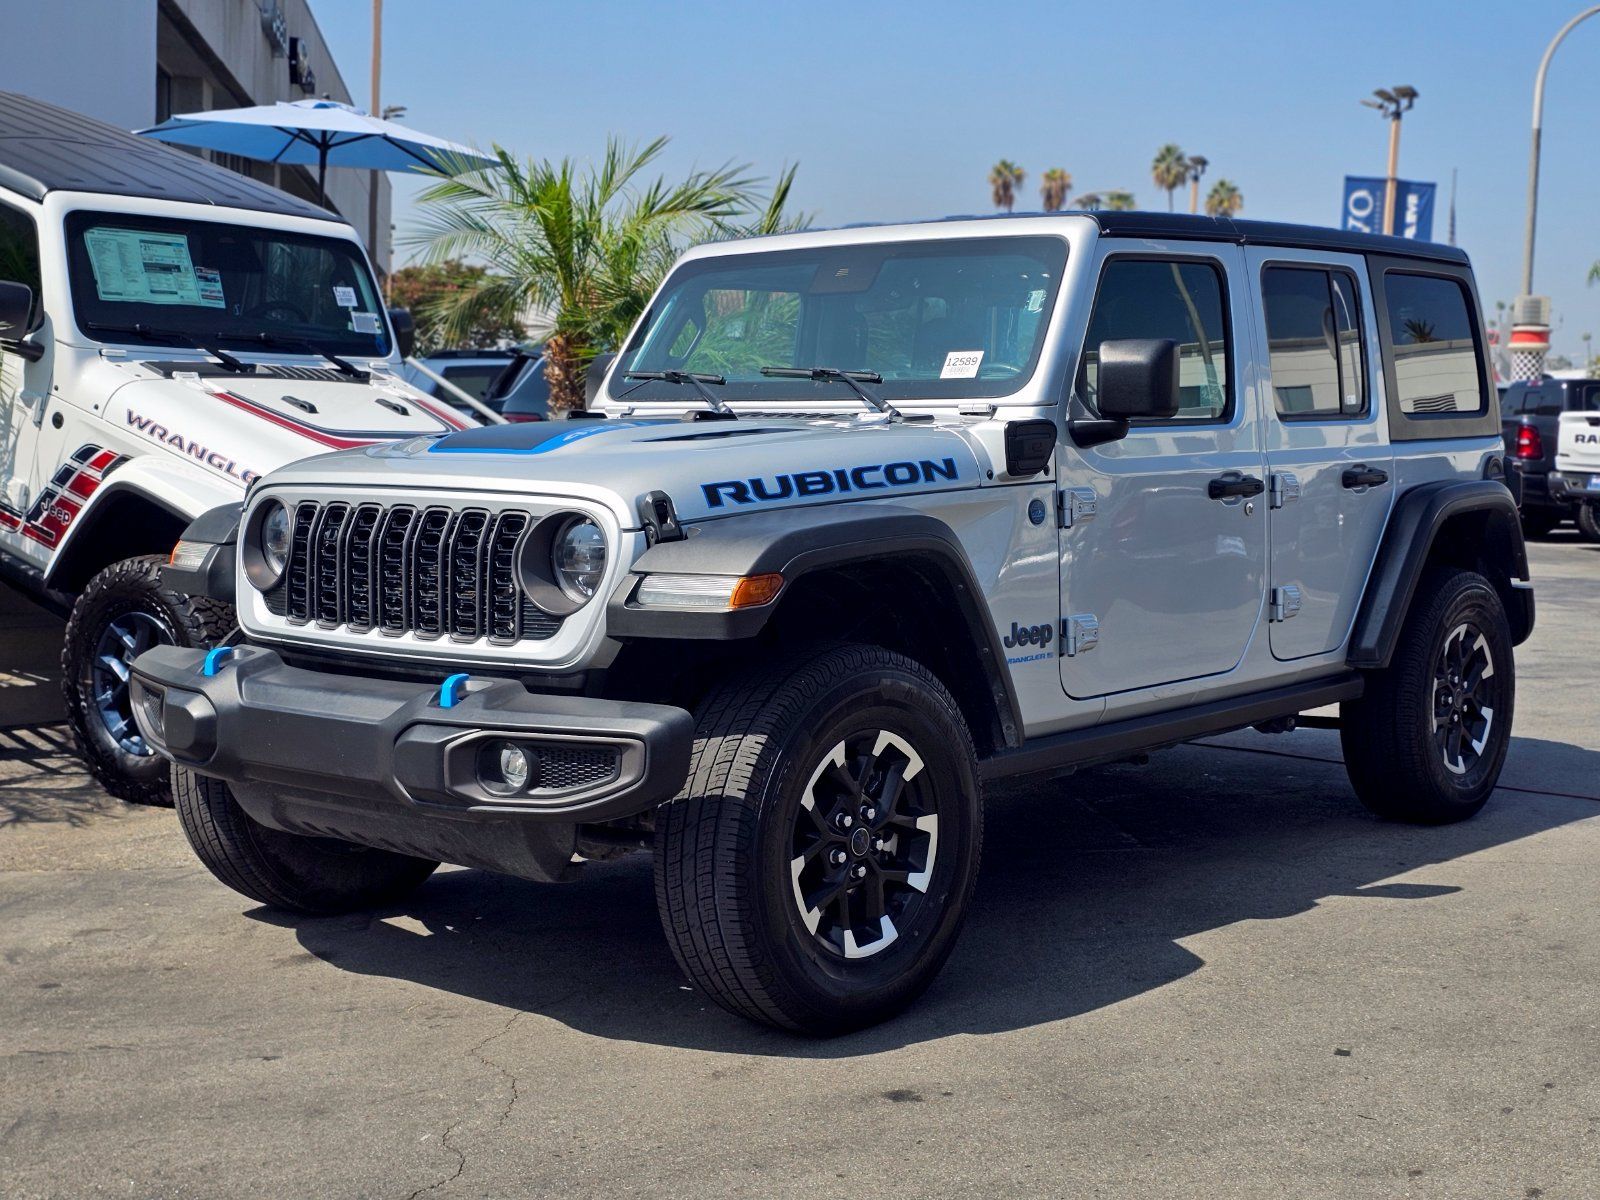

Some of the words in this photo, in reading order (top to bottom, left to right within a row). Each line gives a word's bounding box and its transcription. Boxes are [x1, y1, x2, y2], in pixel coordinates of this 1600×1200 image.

[946, 356, 978, 367] 12589
[126, 408, 258, 484] WRANGLE
[1575, 434, 1600, 444] RA
[700, 457, 959, 508] RUBICON
[40, 497, 72, 526] Jeep
[1003, 621, 1053, 648] Jeep
